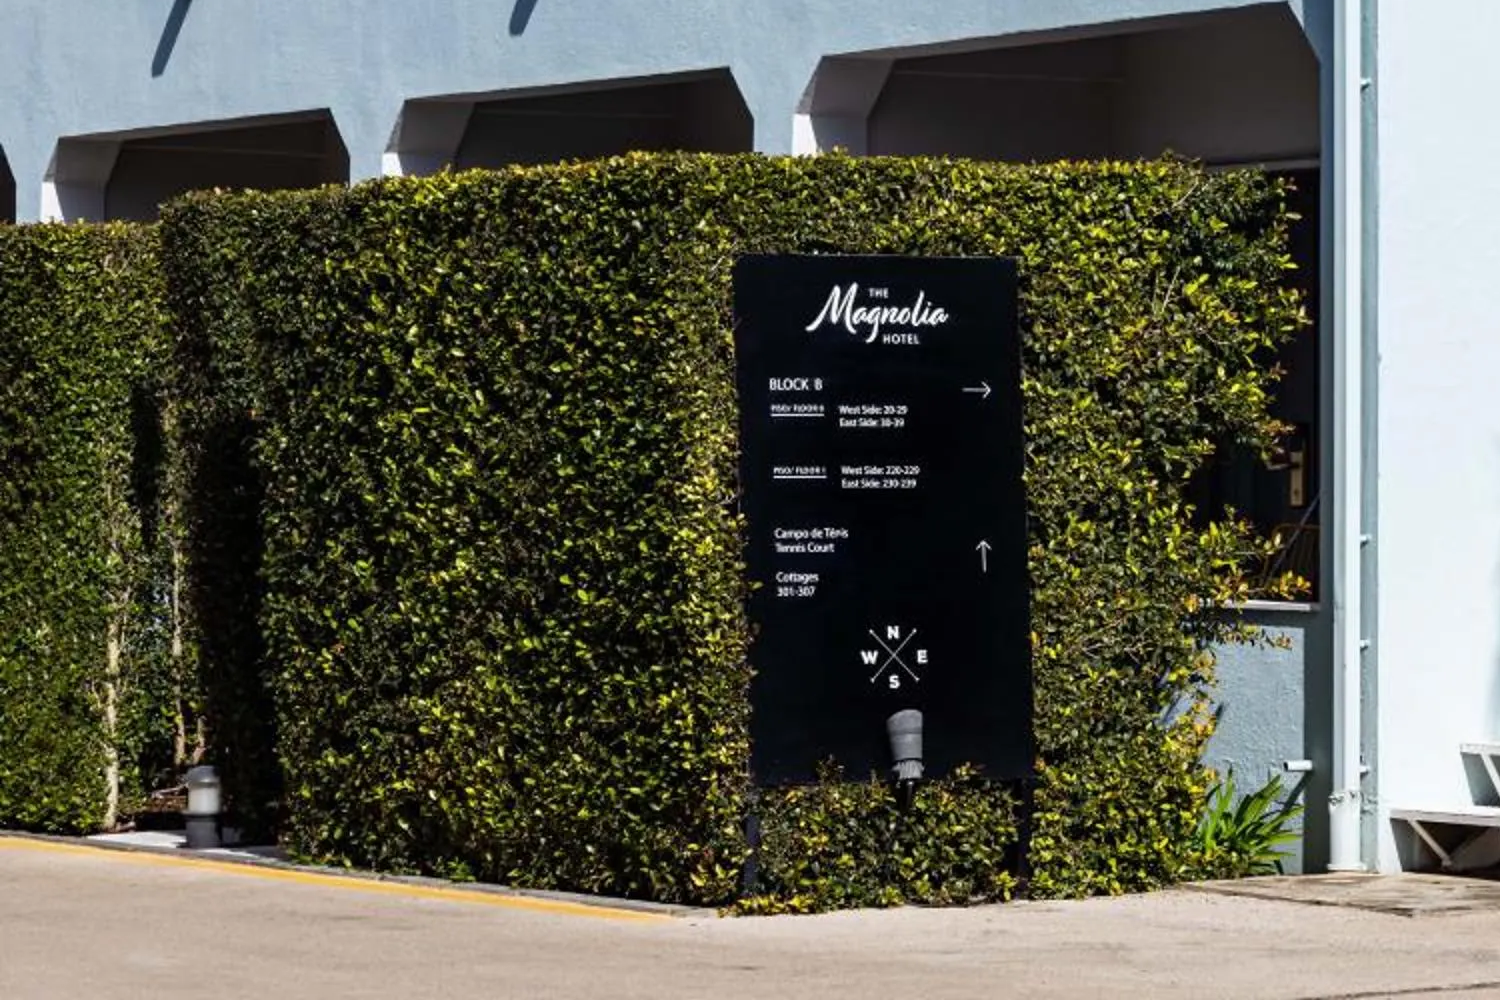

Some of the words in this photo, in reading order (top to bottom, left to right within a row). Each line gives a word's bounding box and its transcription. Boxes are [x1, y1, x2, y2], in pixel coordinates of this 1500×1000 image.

[869, 287, 889, 299] THE
[805, 281, 949, 344] Magnolia
[883, 333, 920, 345] HOTEL
[769, 377, 809, 391] BLOCK
[814, 377, 823, 391] B
[838, 405, 860, 415] West
[839, 417, 857, 428] East
[841, 465, 862, 475] West
[841, 478, 859, 489] East
[774, 527, 808, 541] Campo
[810, 527, 823, 539] de
[775, 542, 806, 553] Tennis
[807, 541, 835, 553] Court
[775, 571, 819, 585] Cottages
[887, 625, 900, 640] N
[860, 650, 878, 665] W
[917, 650, 928, 664] E
[889, 675, 900, 689] S
